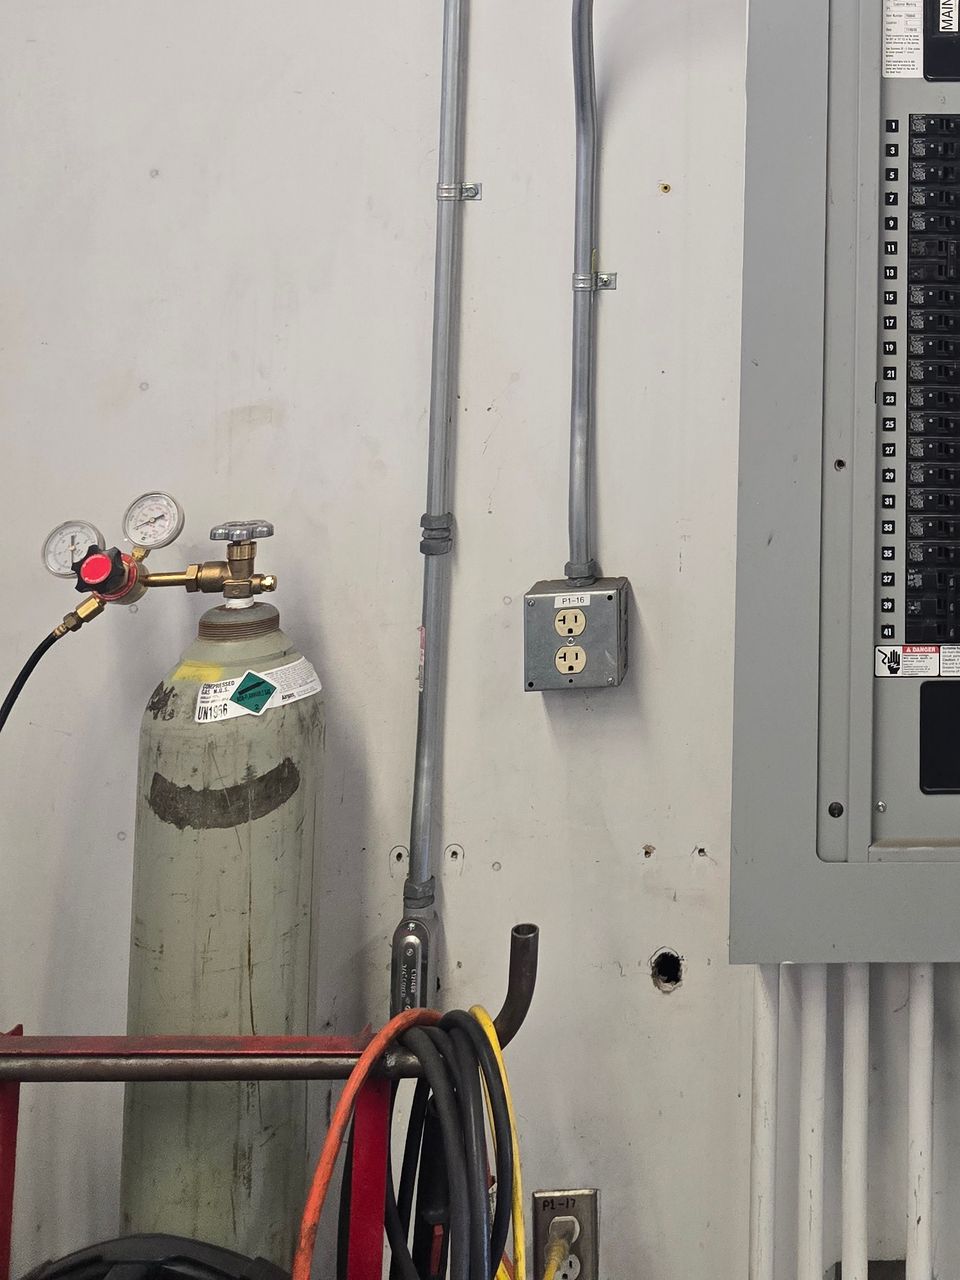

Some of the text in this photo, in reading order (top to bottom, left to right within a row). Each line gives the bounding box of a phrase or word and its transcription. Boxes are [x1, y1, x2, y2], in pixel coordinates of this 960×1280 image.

[887, 244, 895, 252] 11
[886, 268, 895, 277] 13
[885, 293, 894, 301] 15
[885, 318, 895, 327] 17
[885, 343, 894, 352] 19
[886, 369, 895, 378] 21
[885, 395, 895, 403] 23
[885, 420, 895, 429] 25
[885, 446, 895, 455] 27
[885, 471, 894, 480] 29
[884, 497, 893, 506] 31
[883, 523, 893, 532] 33
[883, 549, 893, 558] 35
[882, 575, 893, 583] 37
[562, 597, 585, 605] P1-16
[883, 601, 893, 610] 39
[883, 627, 892, 636] 41
[203, 681, 235, 689] COMPRESSED
[542, 1198, 576, 1211] P1-17
